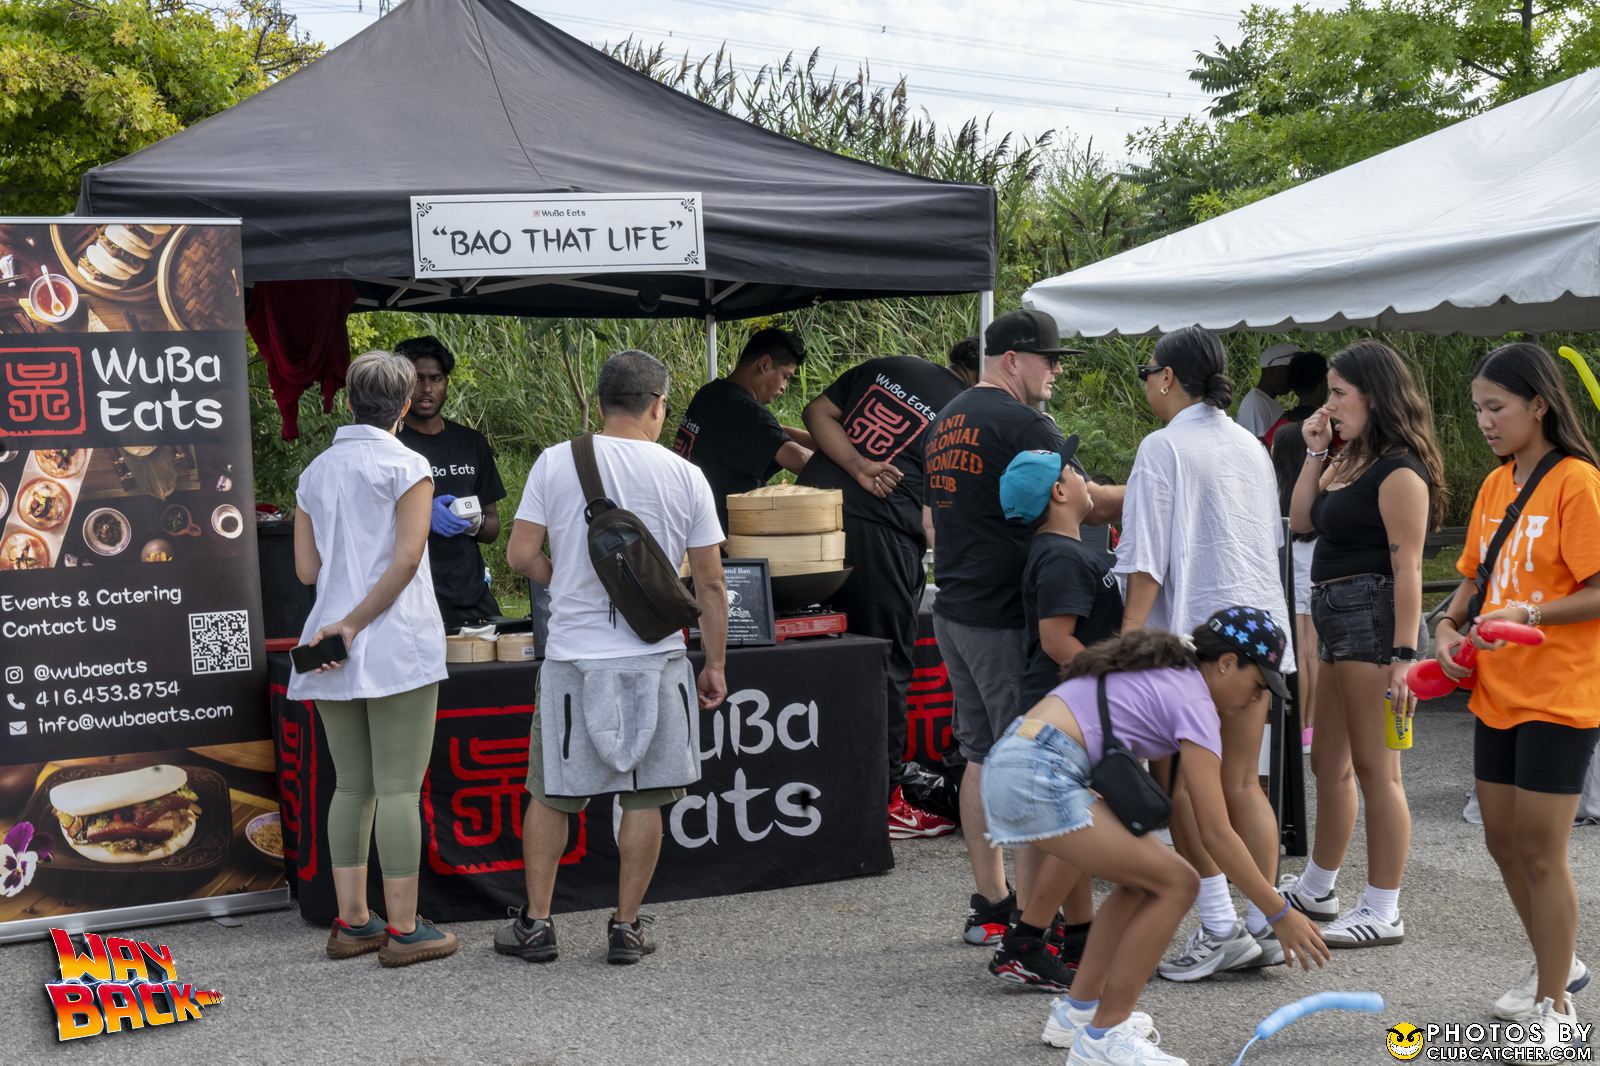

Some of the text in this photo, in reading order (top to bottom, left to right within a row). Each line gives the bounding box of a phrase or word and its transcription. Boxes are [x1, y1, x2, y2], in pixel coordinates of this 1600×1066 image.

[566, 209, 586, 217] Eats
[521, 227, 598, 254] THAT
[91, 346, 221, 385] WuBa
[97, 388, 223, 432] Eats
[875, 373, 936, 421] WuBa Eats
[934, 414, 966, 437] ANTI
[431, 463, 475, 477] Ba Eats
[1, 585, 182, 611] Events & Catering
[2, 616, 117, 638] Contact Us
[34, 658, 148, 681] @wubaeats
[35, 680, 181, 708] 416.453.8754
[38, 704, 233, 735] info@wubaeats.com
[700, 688, 820, 761] uBa
